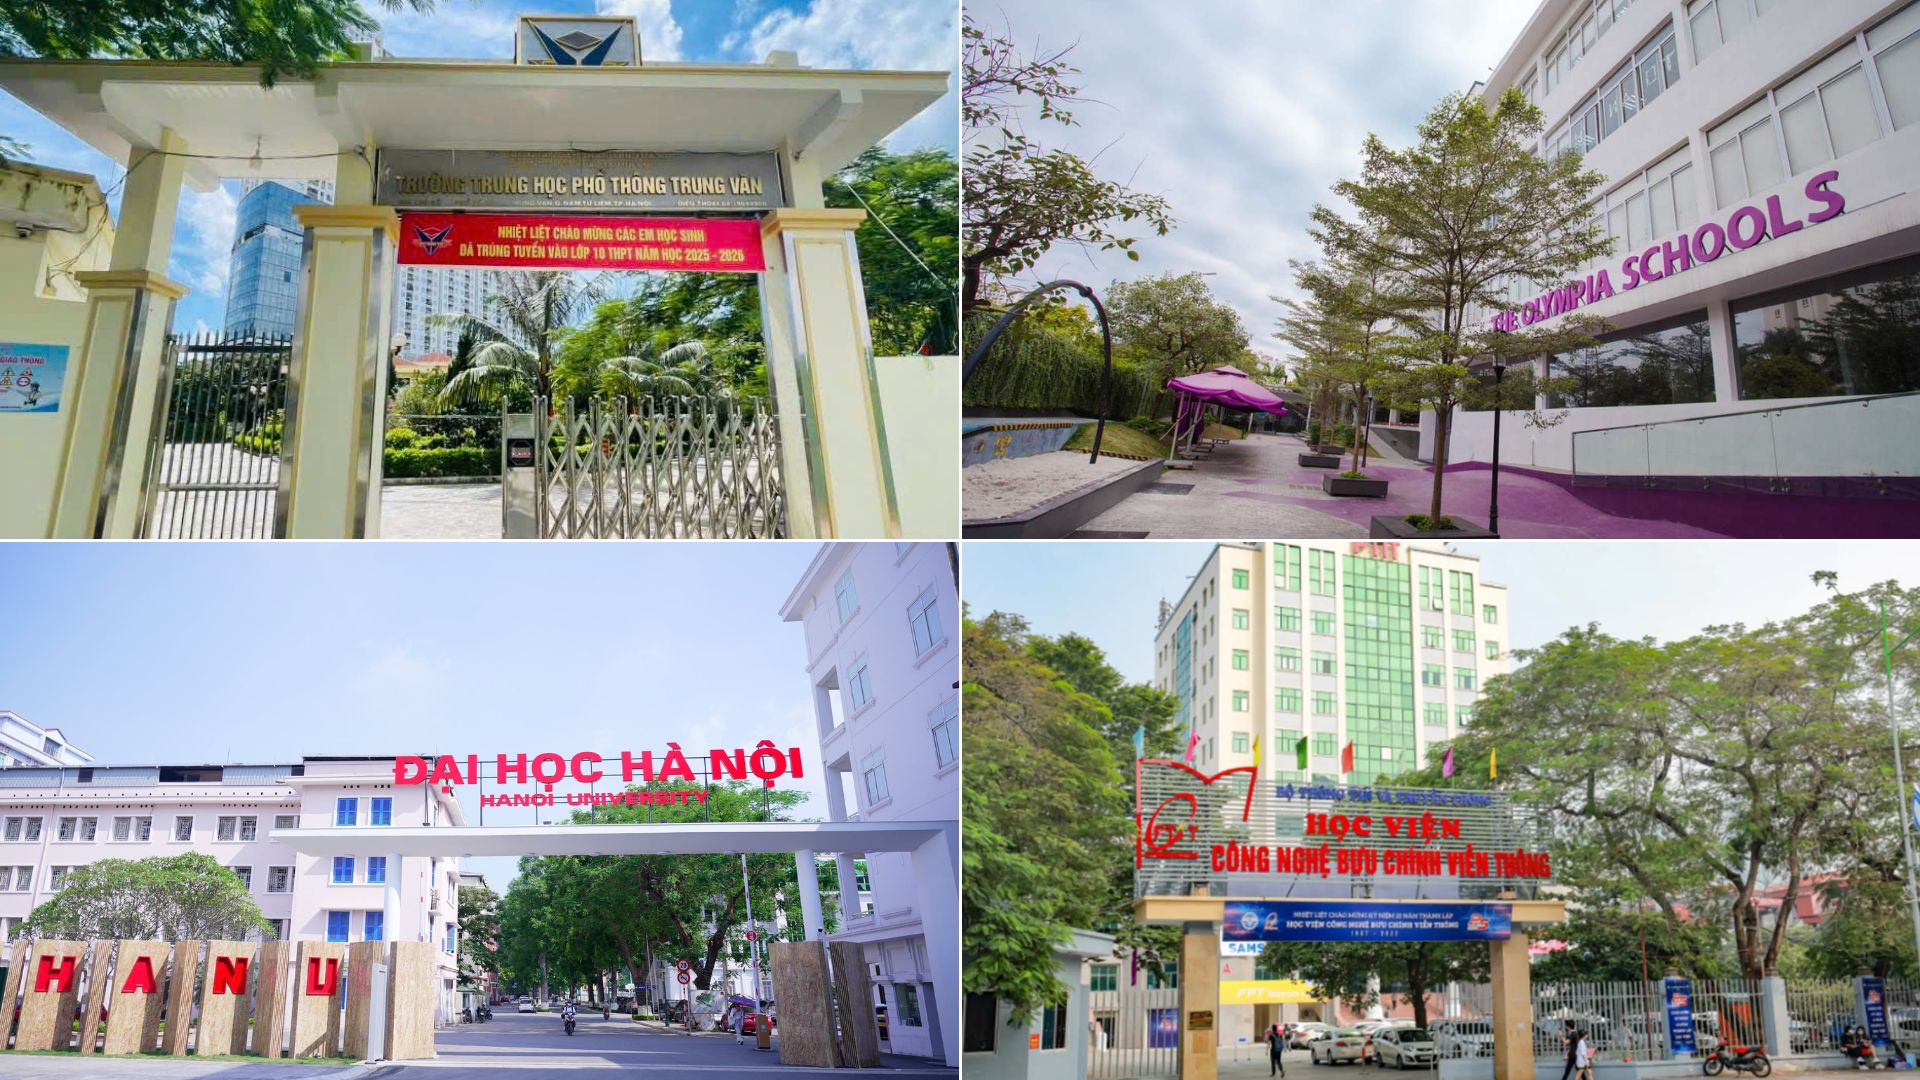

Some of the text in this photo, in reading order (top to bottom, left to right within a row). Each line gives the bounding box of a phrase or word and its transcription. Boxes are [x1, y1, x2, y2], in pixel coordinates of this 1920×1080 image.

[396, 171, 465, 194] TRƯỜNG
[471, 176, 527, 194] TRUNG
[534, 176, 566, 198] HỌC
[572, 169, 606, 194] PHỔ
[611, 172, 666, 194] THÔNG
[671, 176, 725, 195] TRUNG
[498, 224, 705, 244] NHIỆT LIỆT CHÀO MỪNG CÁC EM HỌC SINH
[477, 242, 510, 258] TRÚNG
[513, 244, 545, 259] TUYỂN
[549, 243, 568, 259] VÀO
[571, 244, 590, 260] LỚP
[594, 247, 606, 260] 10
[608, 247, 632, 260] THPT
[635, 245, 660, 261] NĂM
[662, 248, 683, 264] HỌC
[685, 249, 710, 261] 2025
[720, 250, 745, 262] 2026
[1491, 170, 1846, 332] THE OLYMPIA SCHOOLS
[392, 739, 804, 794] ĐẠI HỌC HÀ NỘI
[480, 790, 709, 808] HANOI UNIVERSITY
[1306, 811, 1461, 845] HỌC VIỆN
[1211, 839, 1551, 879] CÔNG NGHỆ BƯU CHÍNH VIỄN THÔNG
[1236, 988, 1265, 999] FPT
